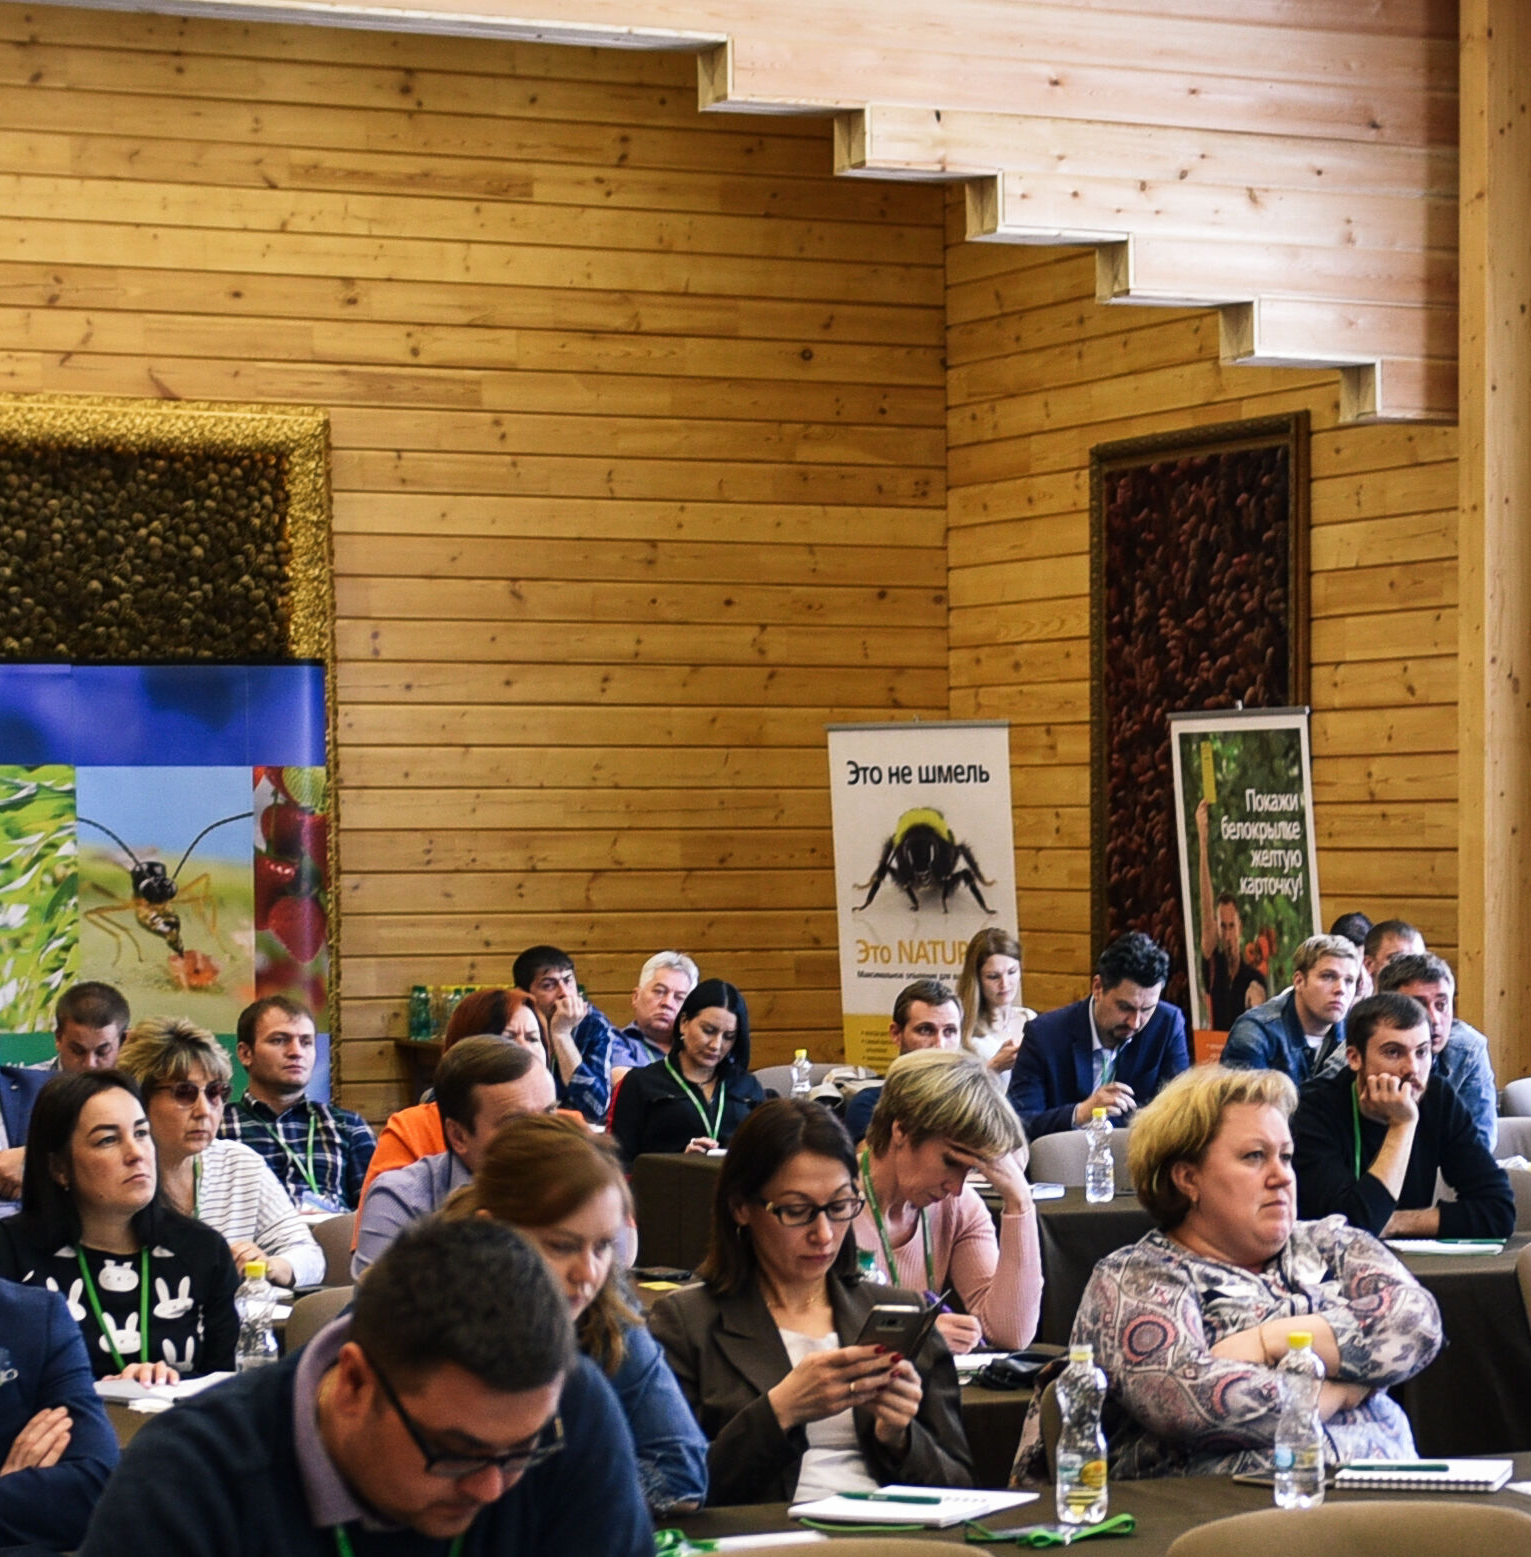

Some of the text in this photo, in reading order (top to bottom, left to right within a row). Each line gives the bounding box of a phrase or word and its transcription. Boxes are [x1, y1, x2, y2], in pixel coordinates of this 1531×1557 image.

[847, 760, 990, 785] Это не шмель
[1245, 788, 1299, 813] Покажи
[1220, 815, 1301, 846] белокрылке
[1250, 849, 1303, 874] желтую
[1240, 872, 1304, 902] карточку!
[855, 938, 892, 964] Это
